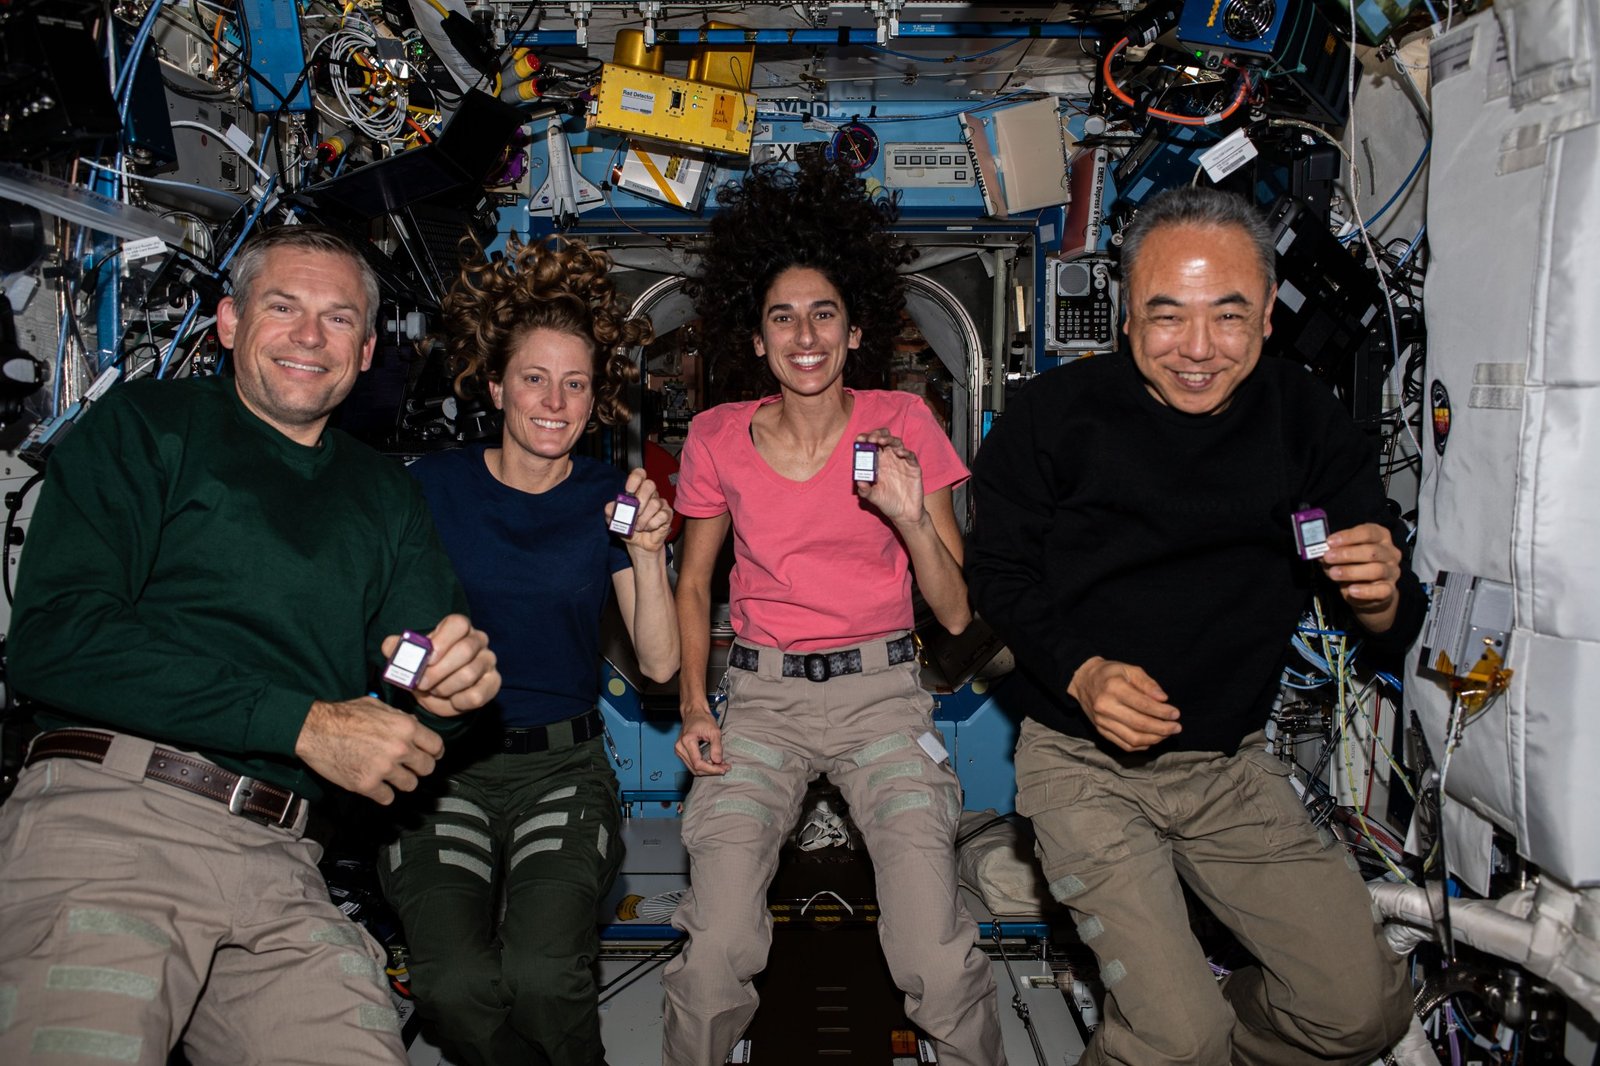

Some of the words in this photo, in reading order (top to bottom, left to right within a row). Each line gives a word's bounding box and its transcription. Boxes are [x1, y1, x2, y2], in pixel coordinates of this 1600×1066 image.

[633, 91, 654, 101] Detector
[966, 138, 988, 197] WARNING
[1093, 186, 1103, 209] Depress
